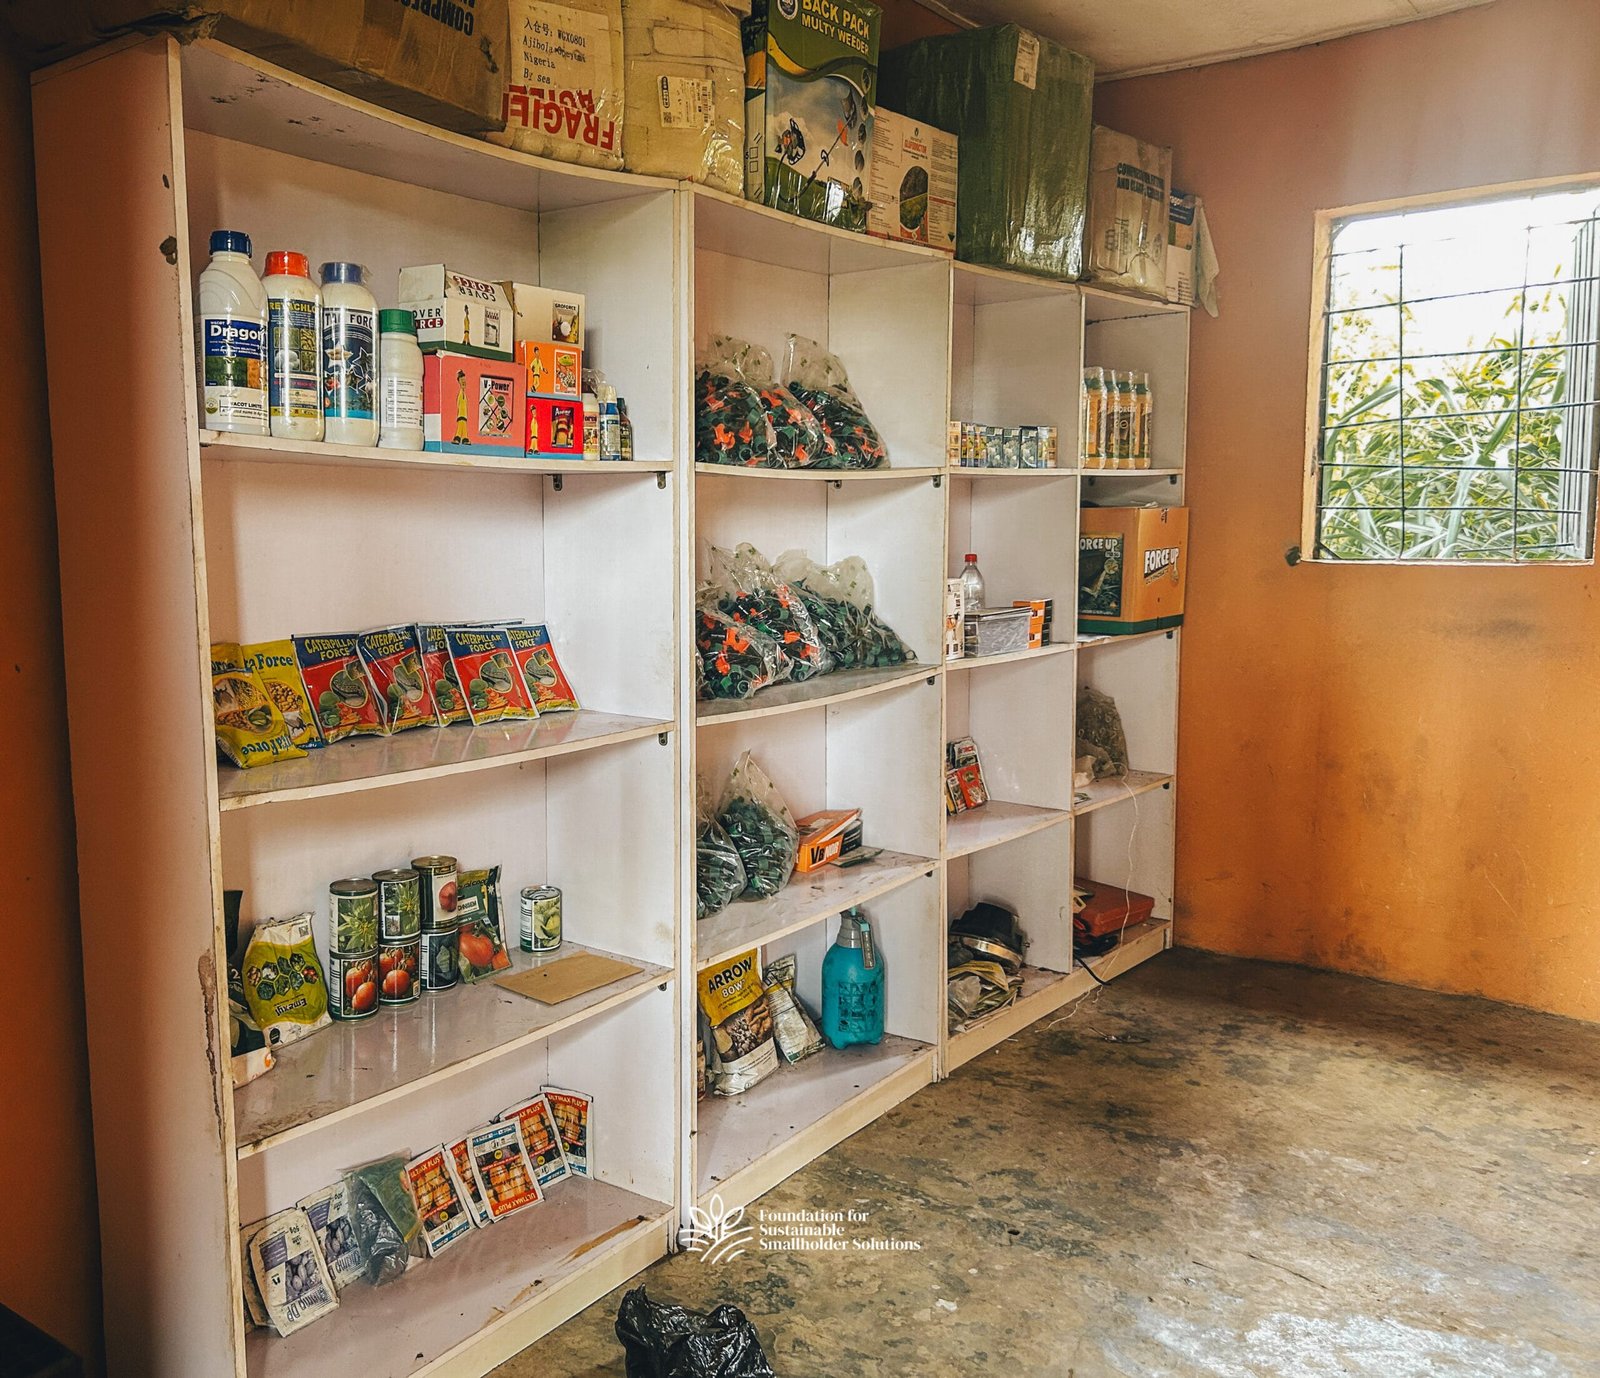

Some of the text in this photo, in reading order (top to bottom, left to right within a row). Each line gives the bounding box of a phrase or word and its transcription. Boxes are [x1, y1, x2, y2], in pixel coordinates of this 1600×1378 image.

[802, 0, 870, 40] BACK PACK
[801, 13, 869, 56] MULTY WEEDER
[523, 51, 556, 69] Nigeria
[537, 74, 551, 84] sea
[458, 285, 496, 302] COVER
[412, 307, 441, 319] OVER
[417, 318, 441, 329] RCE
[1080, 538, 1118, 552] ORCE UP
[1144, 548, 1170, 575] FORCE
[455, 633, 501, 646] CATERPILLAR
[508, 629, 541, 641] ATERPILLAR
[377, 641, 405, 656] FORCE
[469, 642, 496, 652] FORCE
[515, 639, 536, 648] FORCE
[320, 647, 350, 660] FORCE
[255, 653, 293, 670] Force
[708, 956, 752, 994] ARROW
